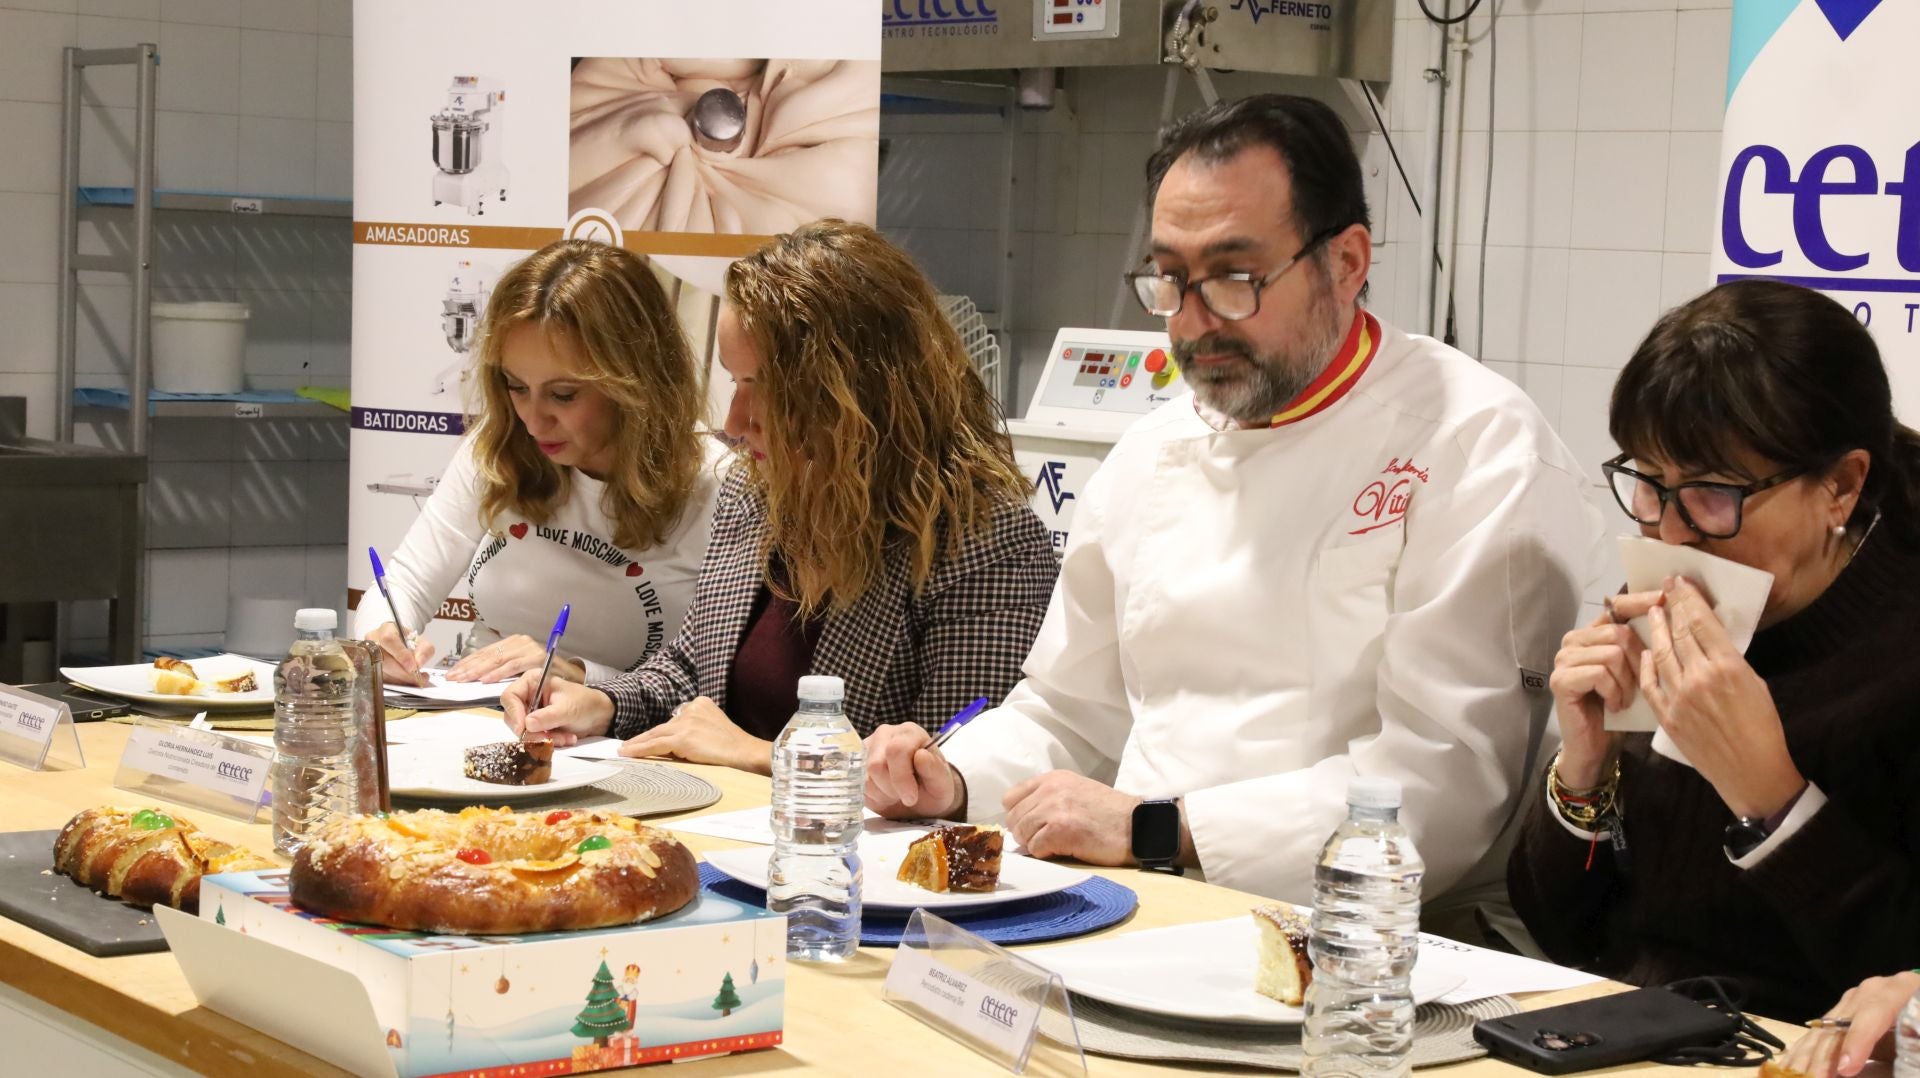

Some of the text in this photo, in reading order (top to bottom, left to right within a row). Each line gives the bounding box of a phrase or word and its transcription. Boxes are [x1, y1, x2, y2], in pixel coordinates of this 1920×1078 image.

[1270, 0, 1332, 19] FERNETO
[881, 24, 999, 39] ENTRO TECNOLÓGICO
[1721, 138, 1920, 273] cet
[365, 225, 471, 245] AMASADORAS
[1904, 303, 1920, 333] T
[363, 411, 448, 432] BATIDORAS
[536, 524, 569, 546] LOVE
[635, 580, 662, 618] LOVE
[217, 760, 253, 781] cetece
[928, 967, 947, 984] BEATRIZ
[979, 994, 1019, 1027] cetece
